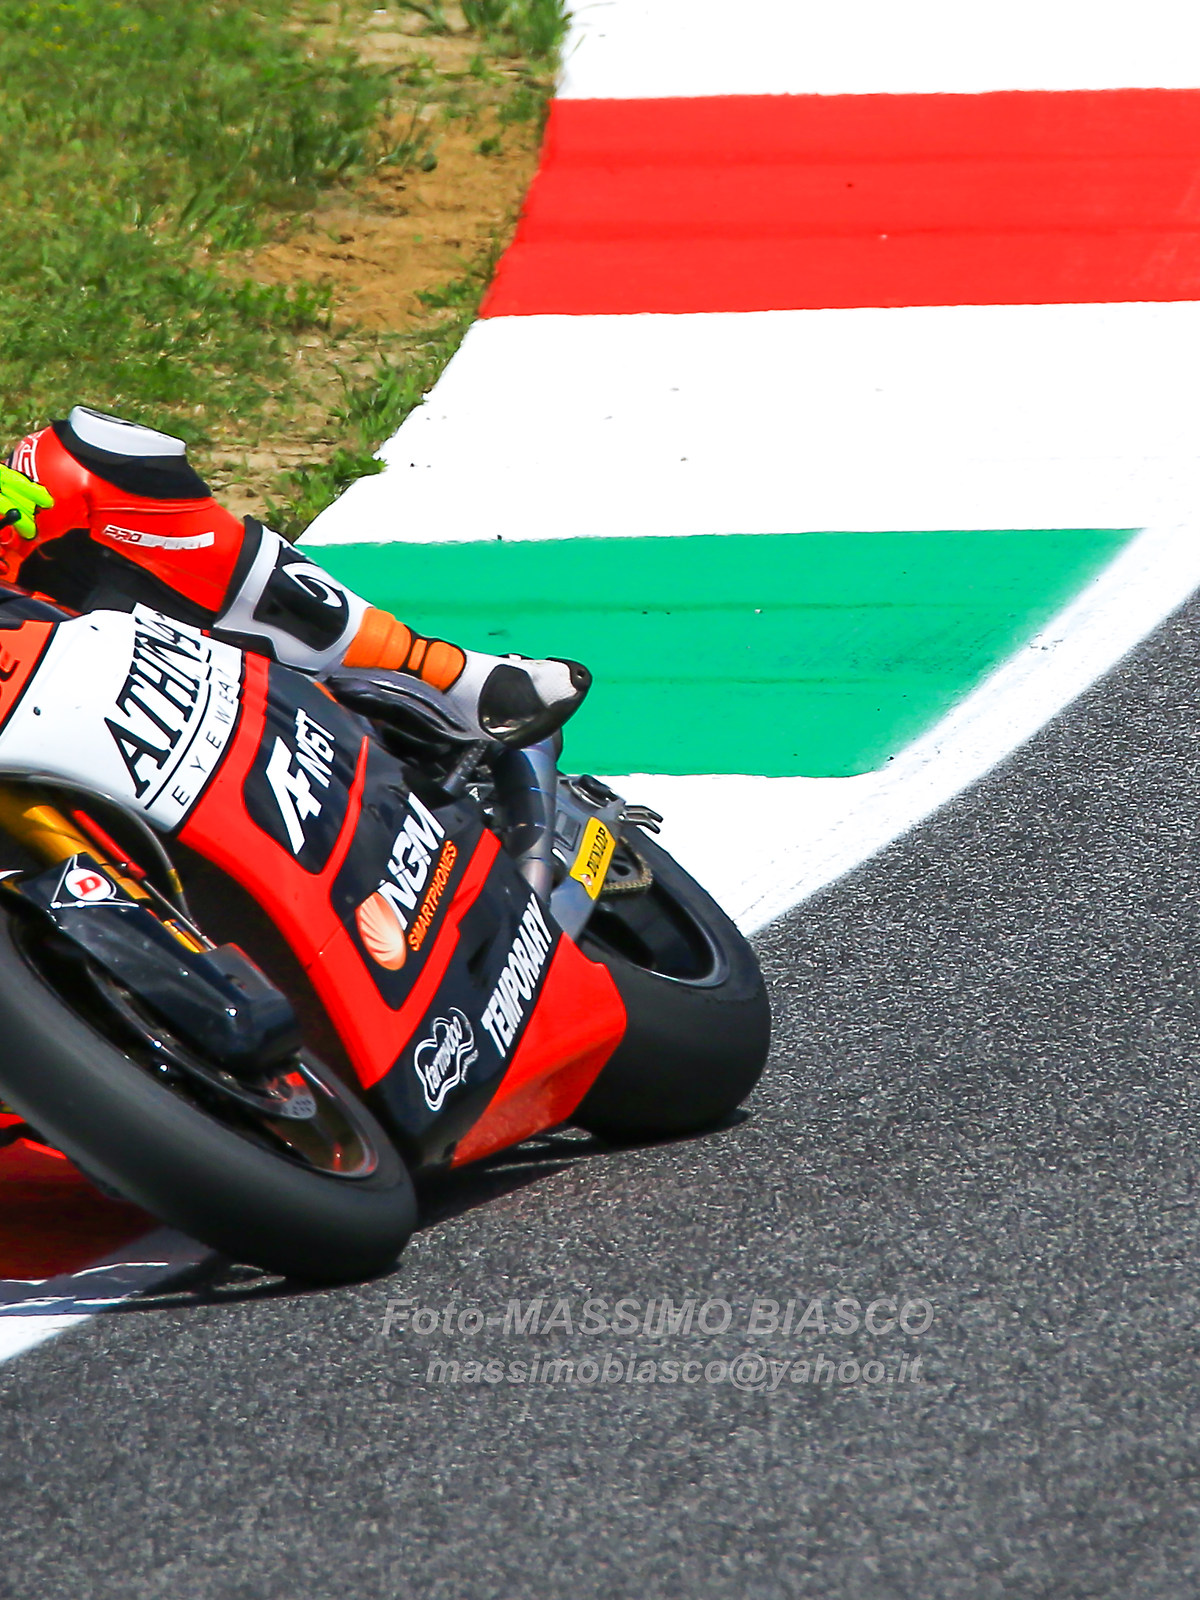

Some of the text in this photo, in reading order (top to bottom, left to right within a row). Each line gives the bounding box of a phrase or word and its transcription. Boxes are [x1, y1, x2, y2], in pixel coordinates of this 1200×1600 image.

[104, 613, 202, 799] ATHINA
[172, 668, 234, 806] EYEWEA
[377, 792, 446, 931] NGM
[408, 840, 457, 951] SMARTPHONES
[587, 826, 608, 878] DUNLOP
[480, 892, 552, 1058] TEMPORARY
